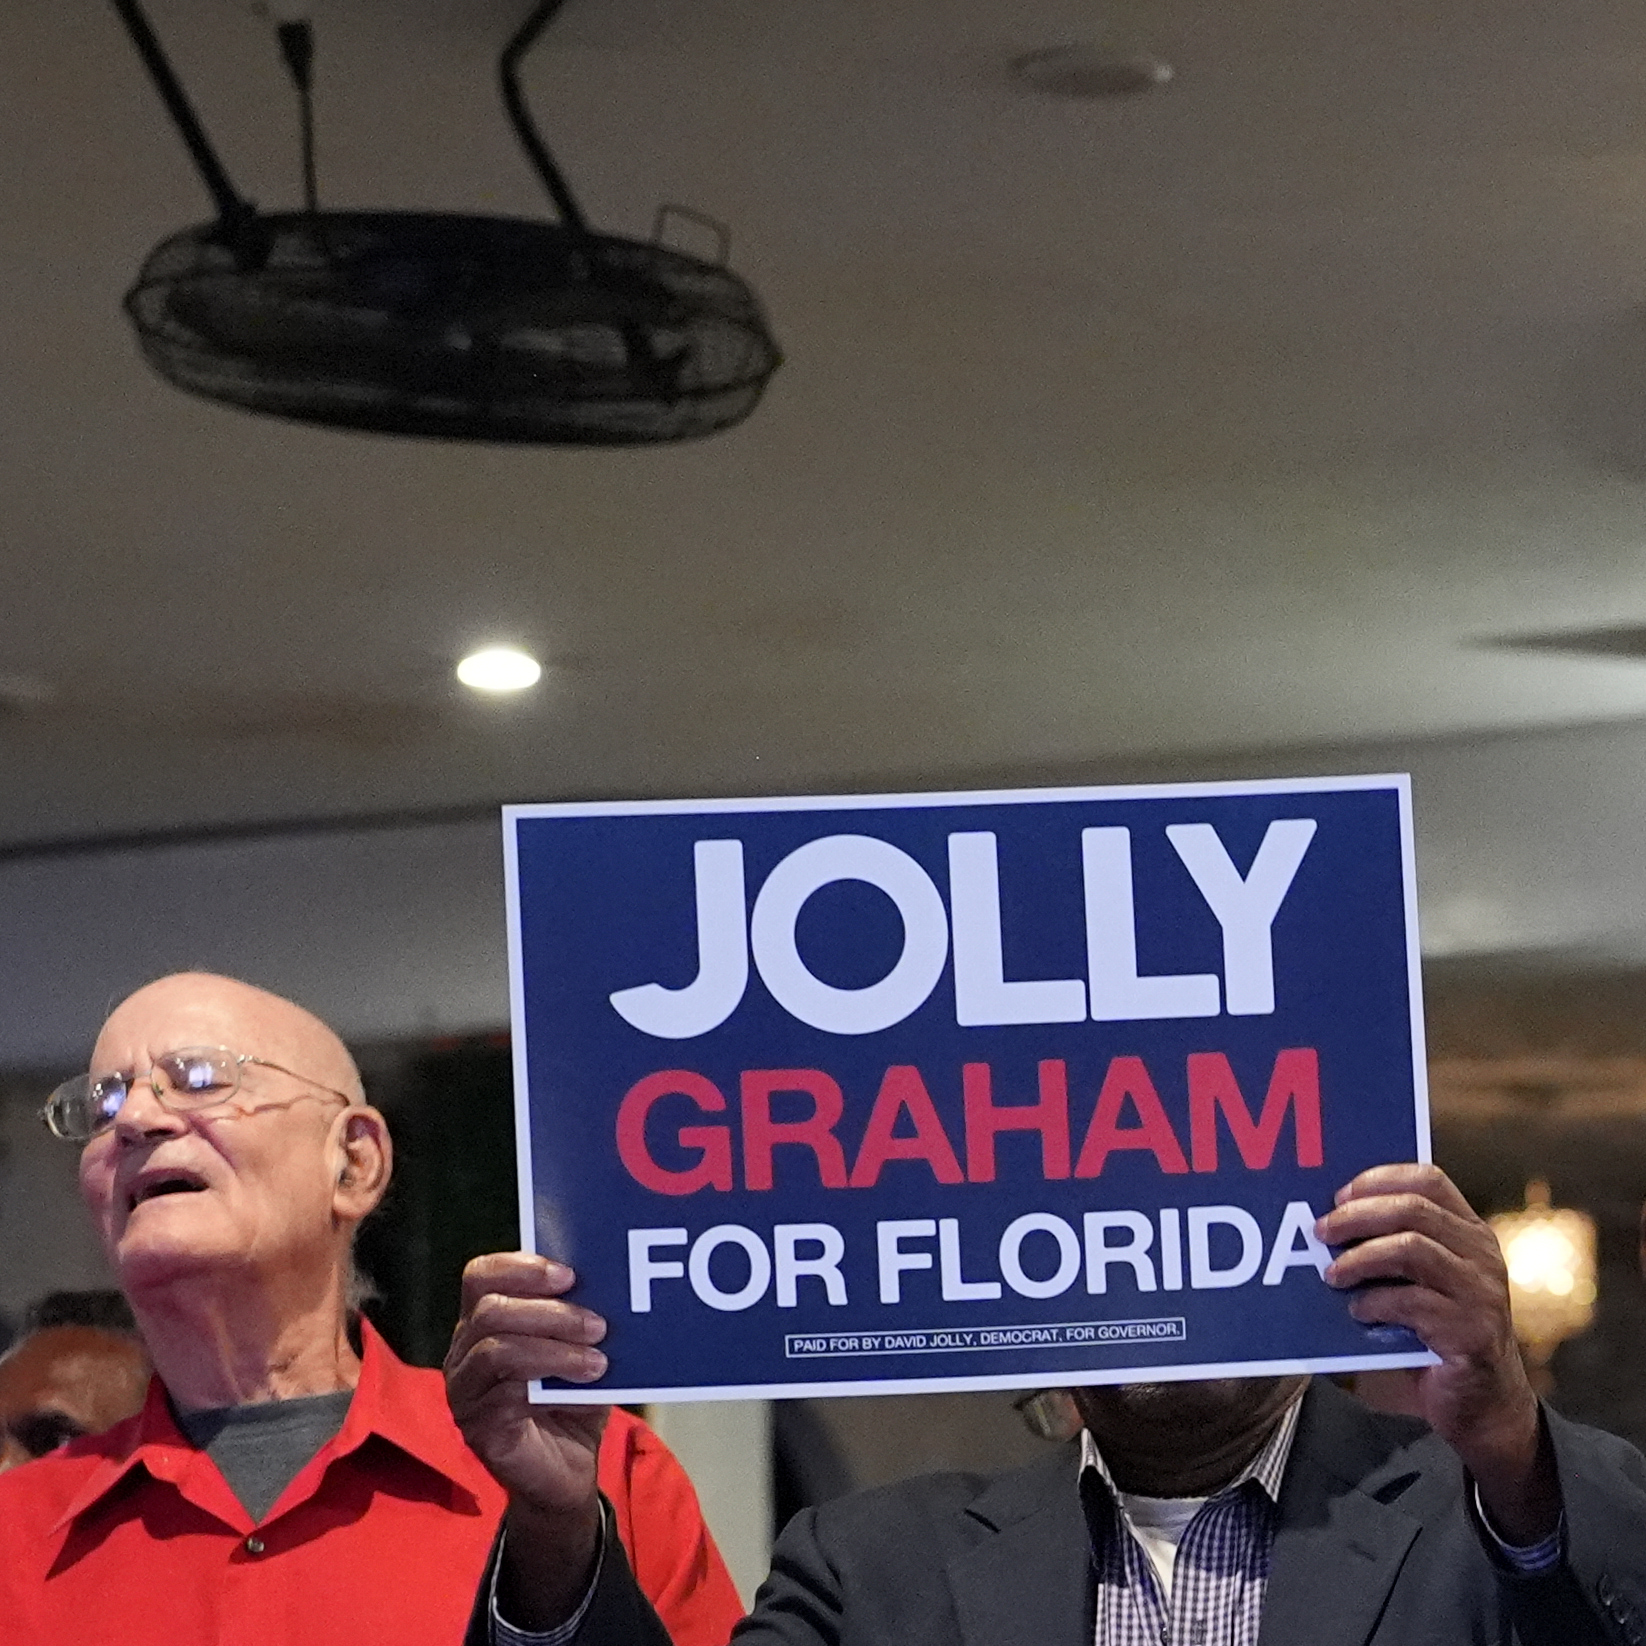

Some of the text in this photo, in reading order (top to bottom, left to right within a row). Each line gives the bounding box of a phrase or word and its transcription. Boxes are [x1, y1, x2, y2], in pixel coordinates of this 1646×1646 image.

[610, 818, 1318, 1039] JOLLY
[616, 1048, 1323, 1196] GRAHAM
[628, 1201, 1333, 1313] FOR FLORIDA
[793, 1338, 827, 1353] PAID
[829, 1336, 860, 1351] FOR
[862, 1334, 882, 1350] BY
[884, 1333, 927, 1349] DAVID
[929, 1331, 977, 1347] JOLLY,
[1066, 1326, 1095, 1341] FOR
[1098, 1322, 1181, 1340] GOVERNOR.
